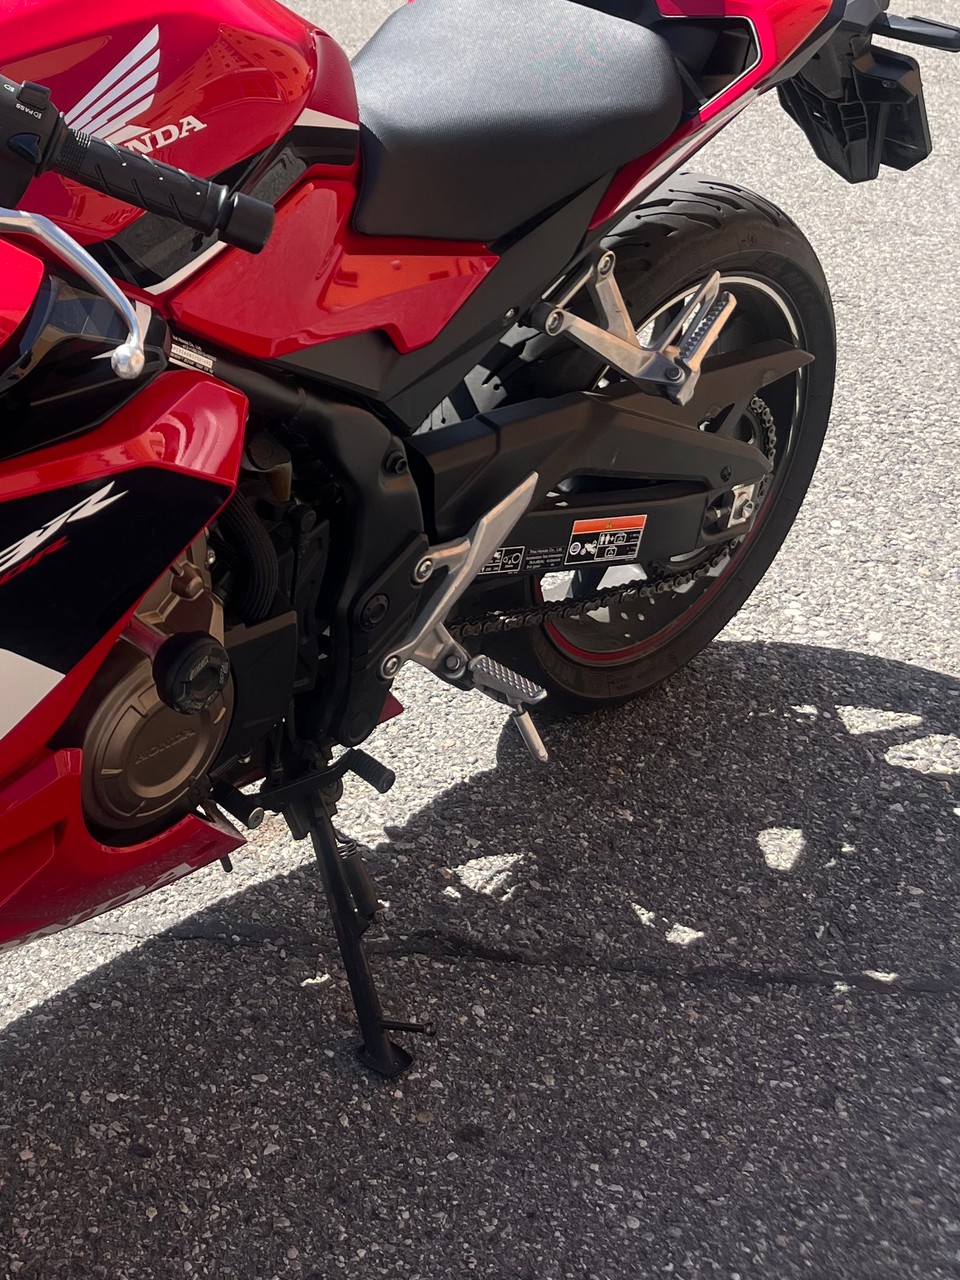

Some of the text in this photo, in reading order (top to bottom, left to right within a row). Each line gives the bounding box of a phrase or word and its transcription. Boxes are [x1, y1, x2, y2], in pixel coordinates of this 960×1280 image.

[15, 103, 34, 115] PASS
[124, 115, 208, 154] NDA
[134, 729, 197, 765] HONDA
